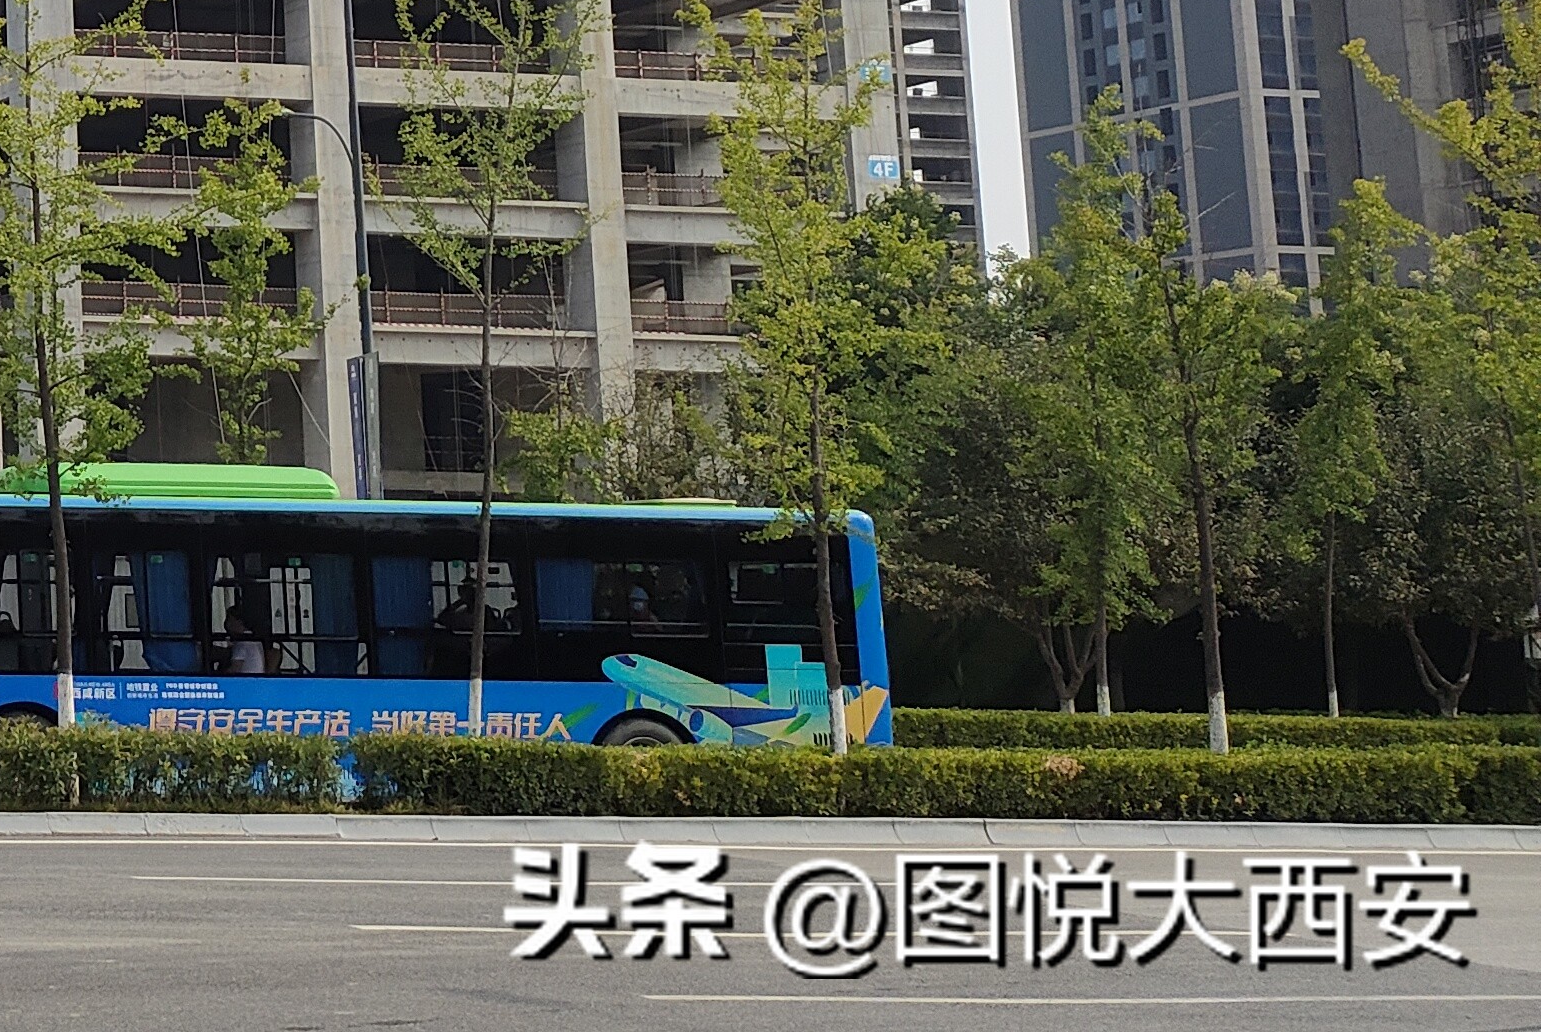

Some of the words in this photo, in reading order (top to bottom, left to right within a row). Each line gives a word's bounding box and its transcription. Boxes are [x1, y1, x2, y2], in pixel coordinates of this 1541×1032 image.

[873, 162, 894, 177] 4F
[149, 708, 351, 737] 遵守安全生产法
[372, 710, 571, 740] 当好第一责任人
